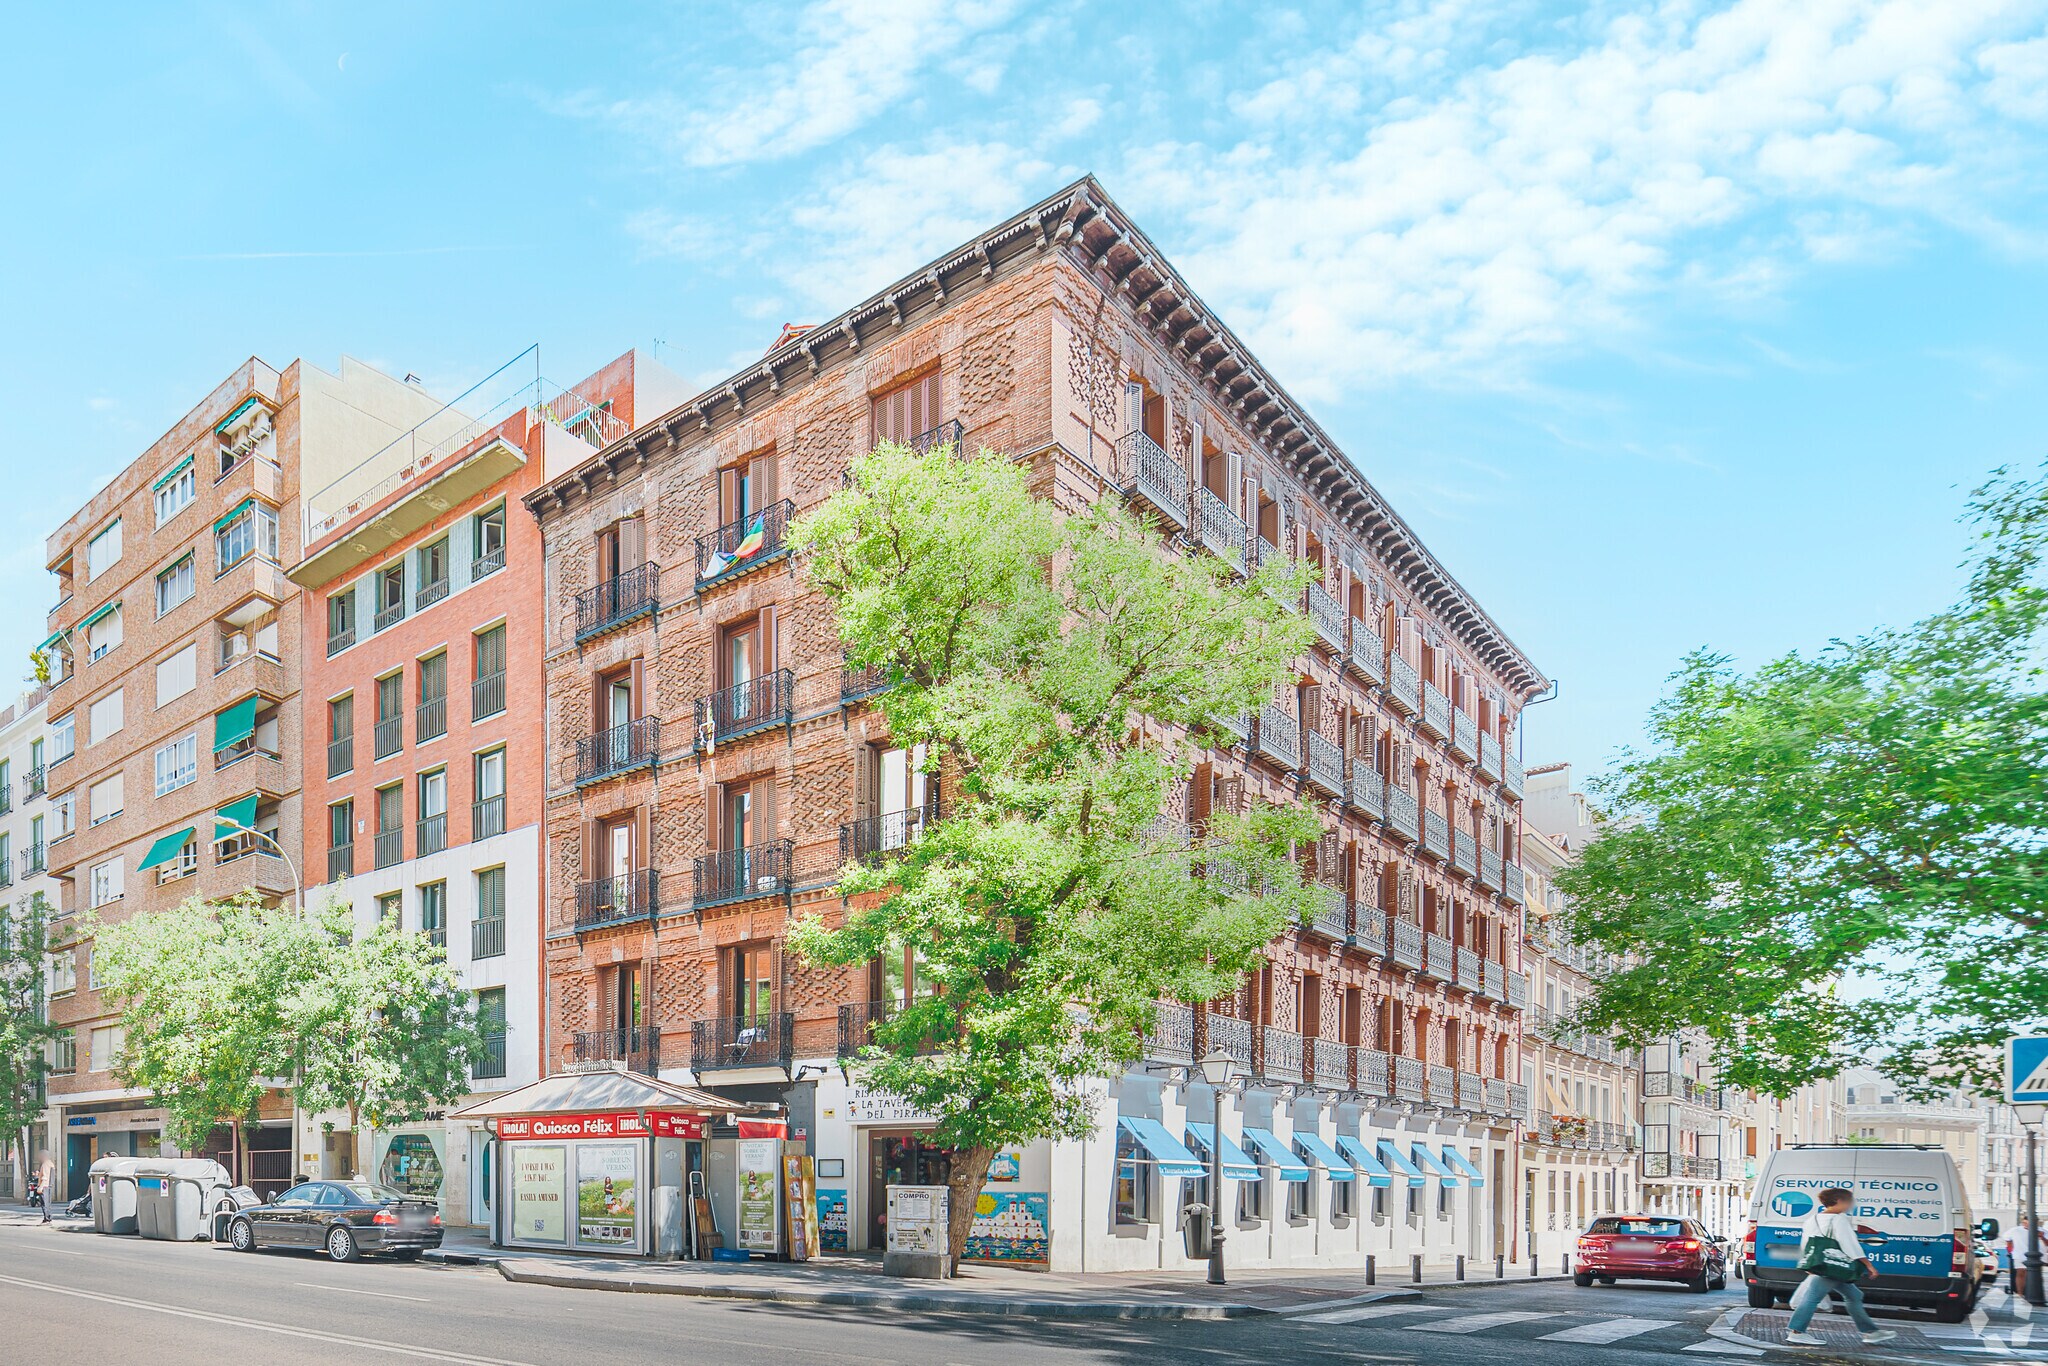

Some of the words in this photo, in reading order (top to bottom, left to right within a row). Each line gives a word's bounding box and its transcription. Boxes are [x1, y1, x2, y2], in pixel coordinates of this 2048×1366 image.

[861, 1100, 873, 1109] LA
[867, 1109, 885, 1119] DEL
[670, 1116, 690, 1125] Quiosco
[502, 1122, 528, 1135] ¡HOLA!
[533, 1120, 581, 1135] Quiosco
[583, 1118, 614, 1133] Félix
[674, 1126, 686, 1135] Félix
[1775, 1179, 1854, 1189] SERVICIO
[1858, 1179, 1939, 1192] TÉCNICO
[1774, 1229, 1803, 1237] info@f
[1868, 1252, 1880, 1262] 91
[1883, 1253, 1900, 1263] 351
[1903, 1254, 1917, 1264] 69
[1918, 1255, 1932, 1265] 45
